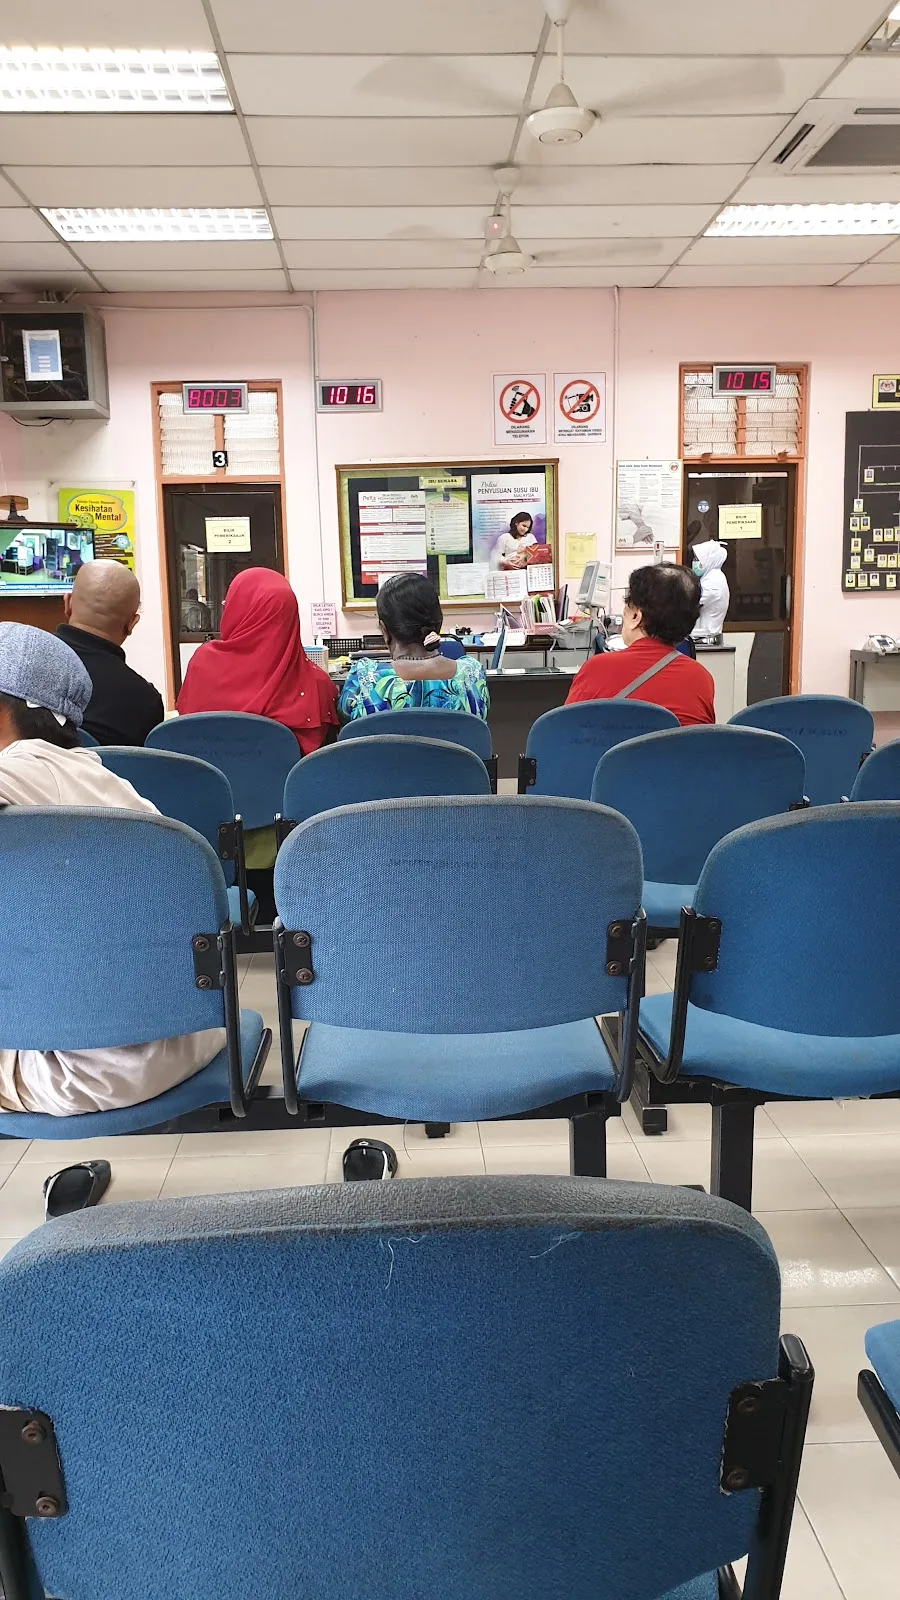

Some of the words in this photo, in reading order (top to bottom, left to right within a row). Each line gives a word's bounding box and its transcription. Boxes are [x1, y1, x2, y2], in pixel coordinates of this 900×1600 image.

[726, 371, 770, 389] 1015
[189, 389, 241, 407] 8003
[329, 386, 375, 404] 1016
[214, 451, 226, 467] 3
[75, 504, 113, 512] Kesihatan
[95, 513, 122, 521] Mental
